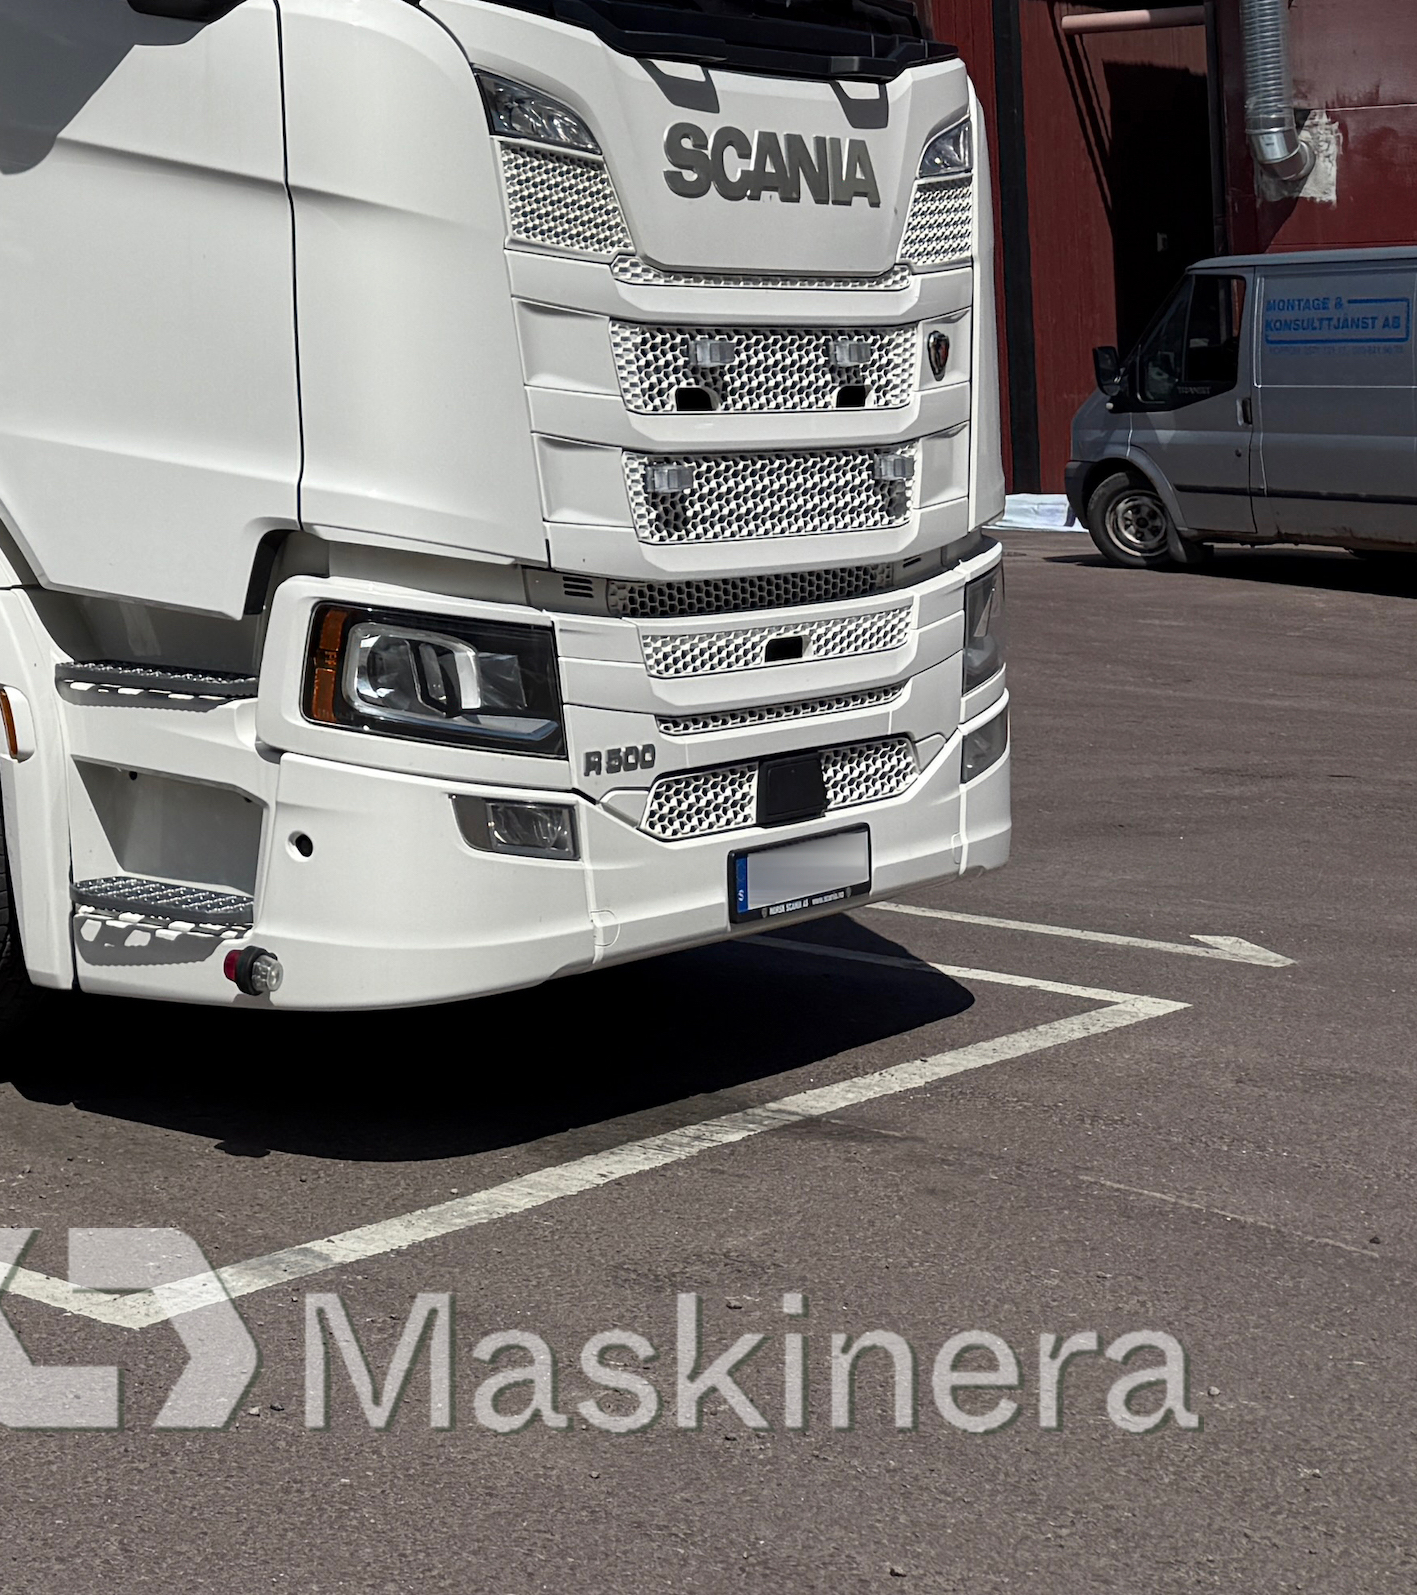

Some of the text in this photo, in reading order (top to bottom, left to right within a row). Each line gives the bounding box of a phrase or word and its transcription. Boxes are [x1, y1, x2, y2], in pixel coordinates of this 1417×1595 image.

[662, 122, 882, 209] SCANIA
[1266, 296, 1343, 312] MONTAGE &
[1382, 315, 1401, 329] AB
[583, 743, 656, 777] R 500
[738, 889, 745, 902] S
